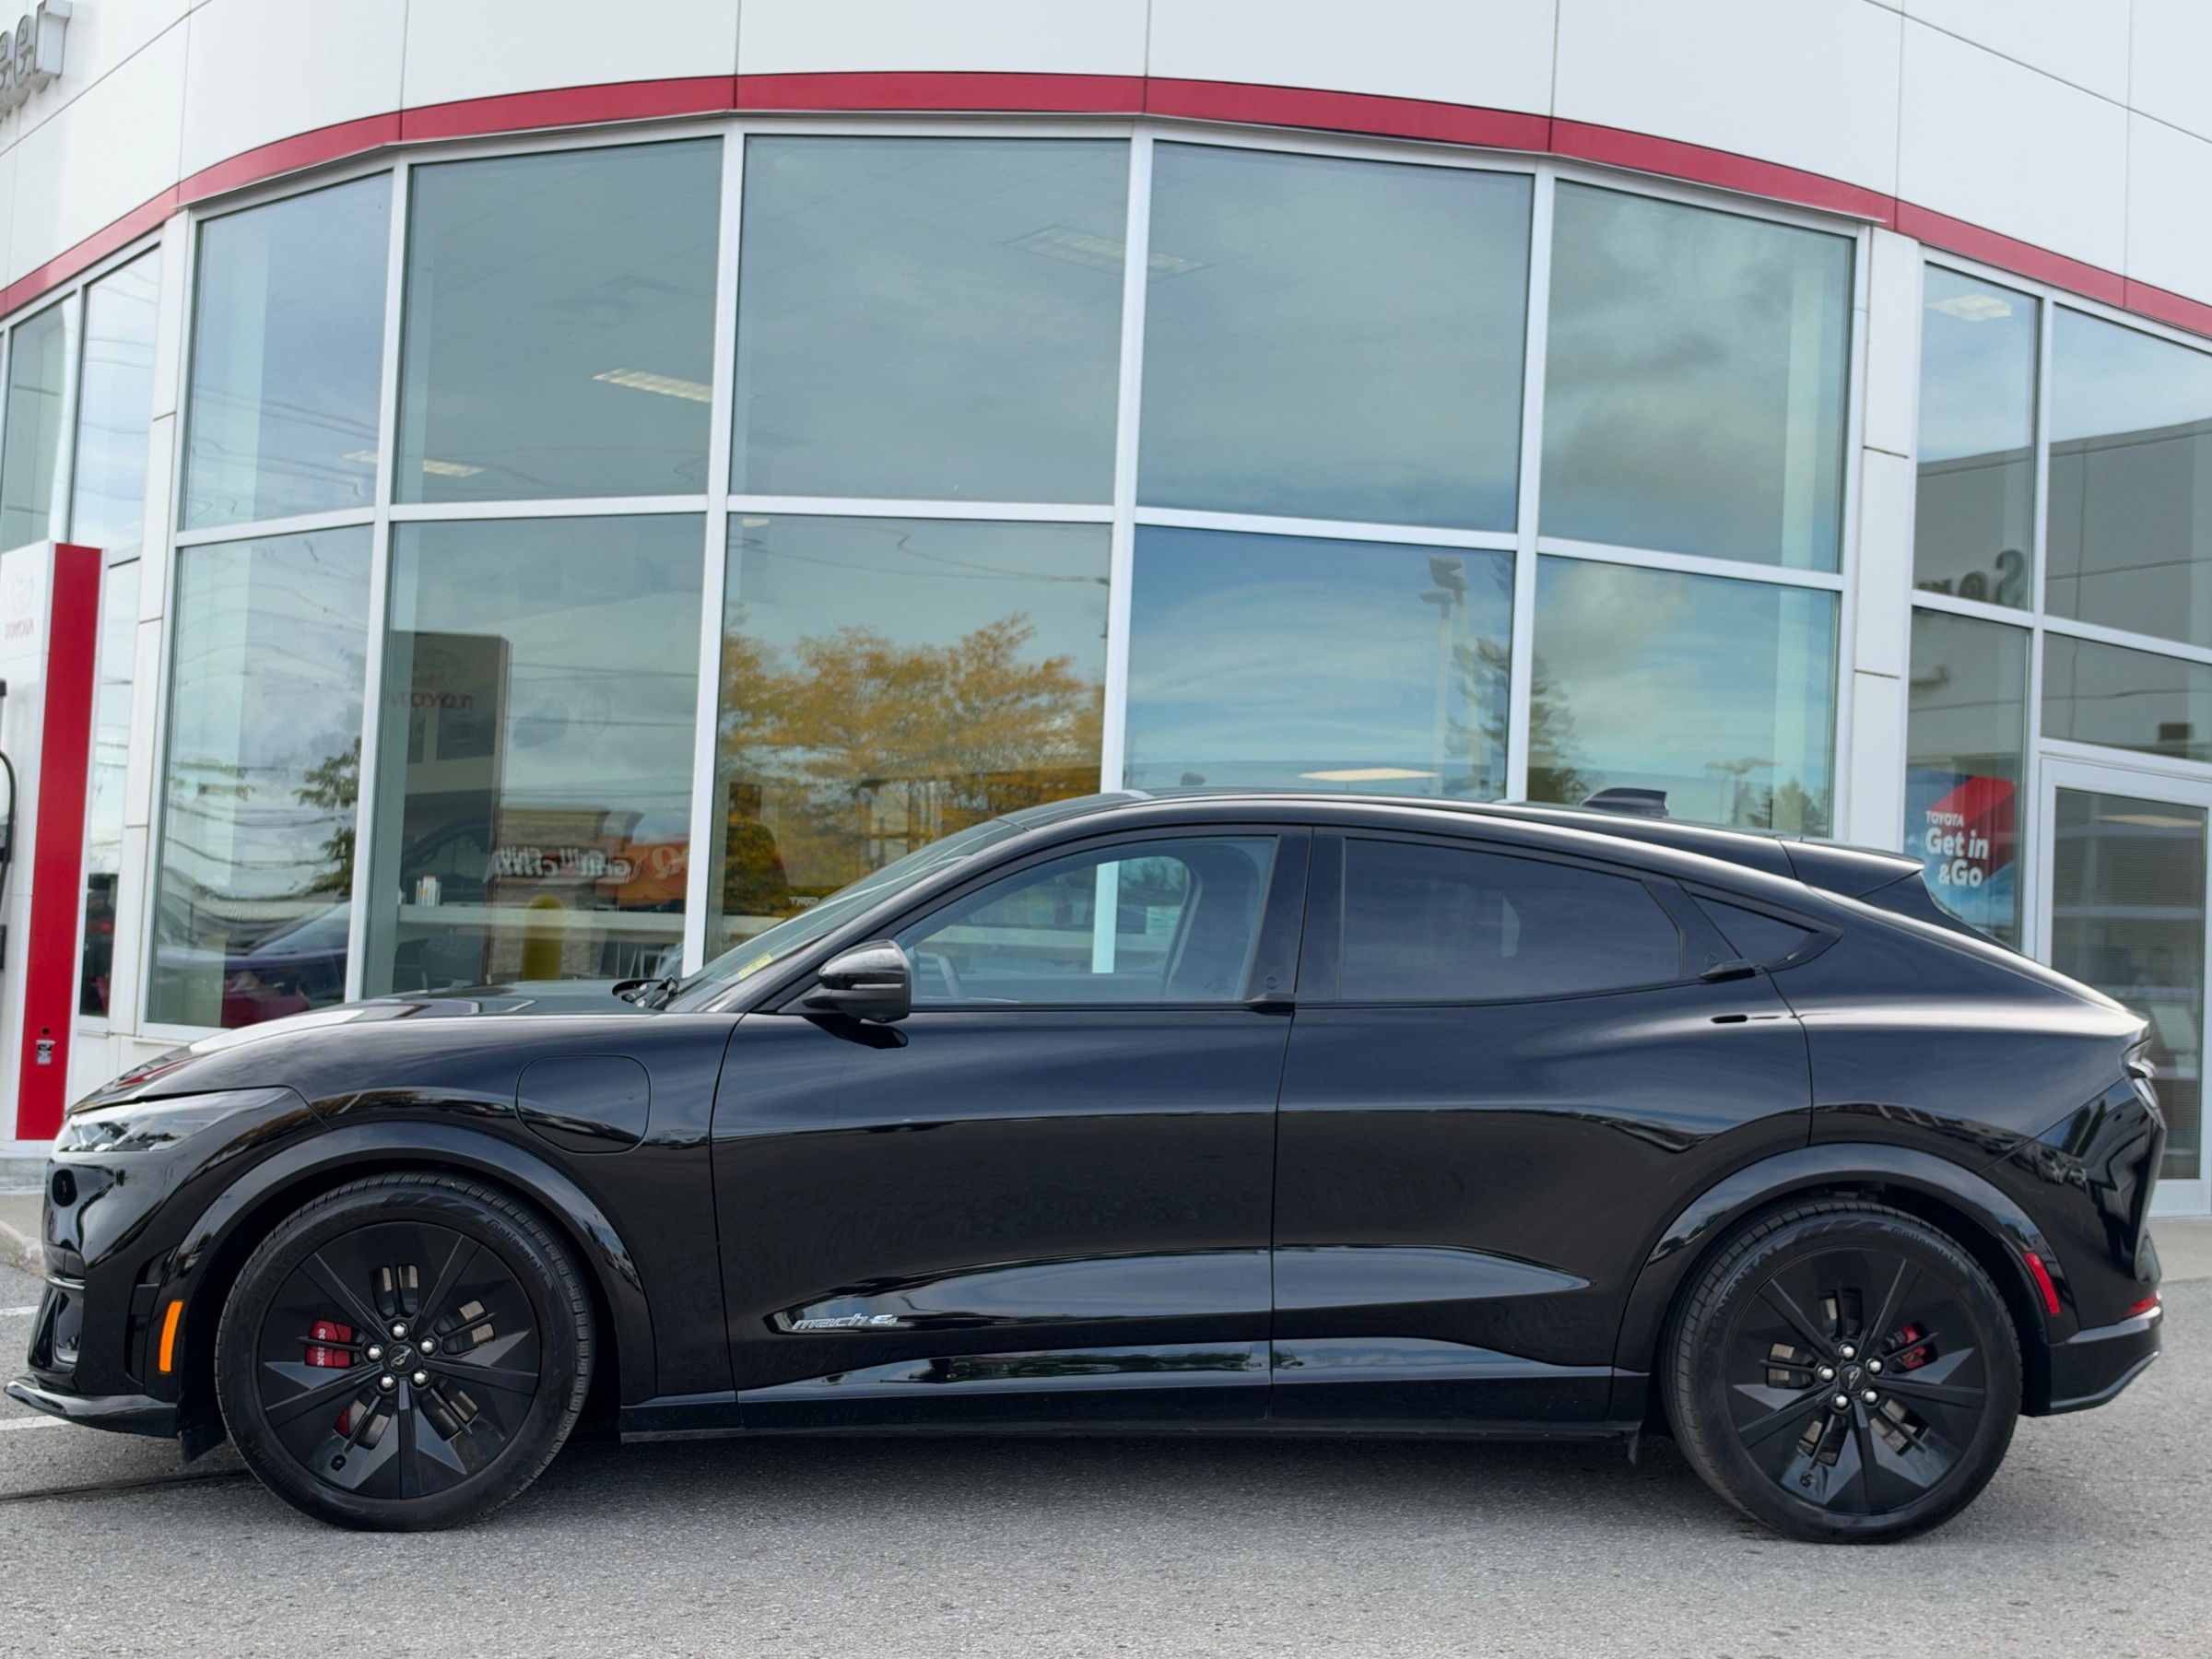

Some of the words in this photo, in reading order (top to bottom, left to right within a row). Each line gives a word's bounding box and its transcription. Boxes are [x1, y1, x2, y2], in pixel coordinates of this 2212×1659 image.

[1925, 810, 1964, 827] TOYOTA
[1925, 827, 1965, 858] Get
[1968, 829, 1989, 860] in
